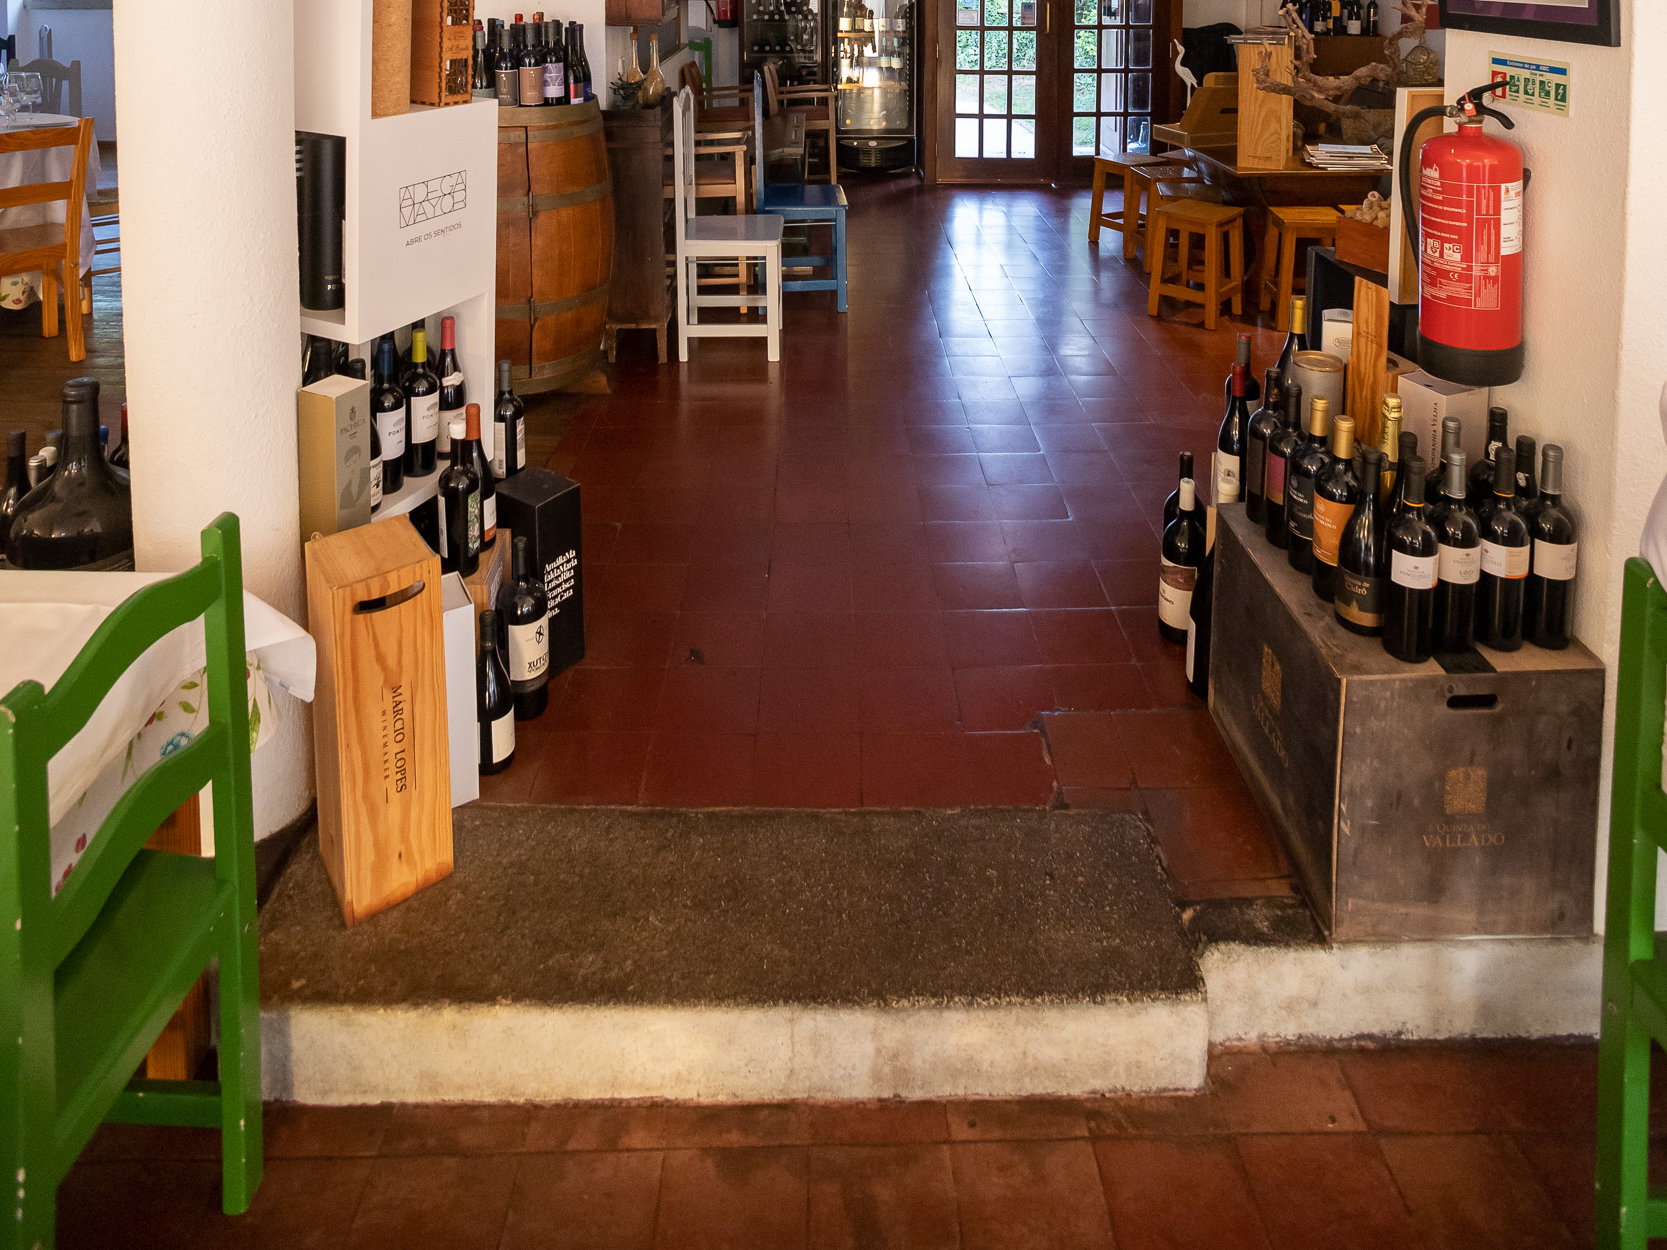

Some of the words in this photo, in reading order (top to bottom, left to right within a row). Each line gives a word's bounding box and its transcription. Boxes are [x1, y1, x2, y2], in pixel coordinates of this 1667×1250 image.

[1531, 78, 1536, 86] B
[1546, 81, 1552, 89] C
[400, 170, 466, 208] ADEGA
[400, 188, 466, 229] MAYOR
[406, 235, 422, 247] ABRE
[424, 231, 432, 240] OS
[433, 221, 462, 238] SENTIDOS
[1430, 429, 1438, 469] OMPANHIA
[392, 684, 405, 744] MÁRCIO
[381, 708, 390, 781] WINEMAKER
[394, 747, 407, 794] LOPES
[1422, 832, 1505, 847] VALLADO
